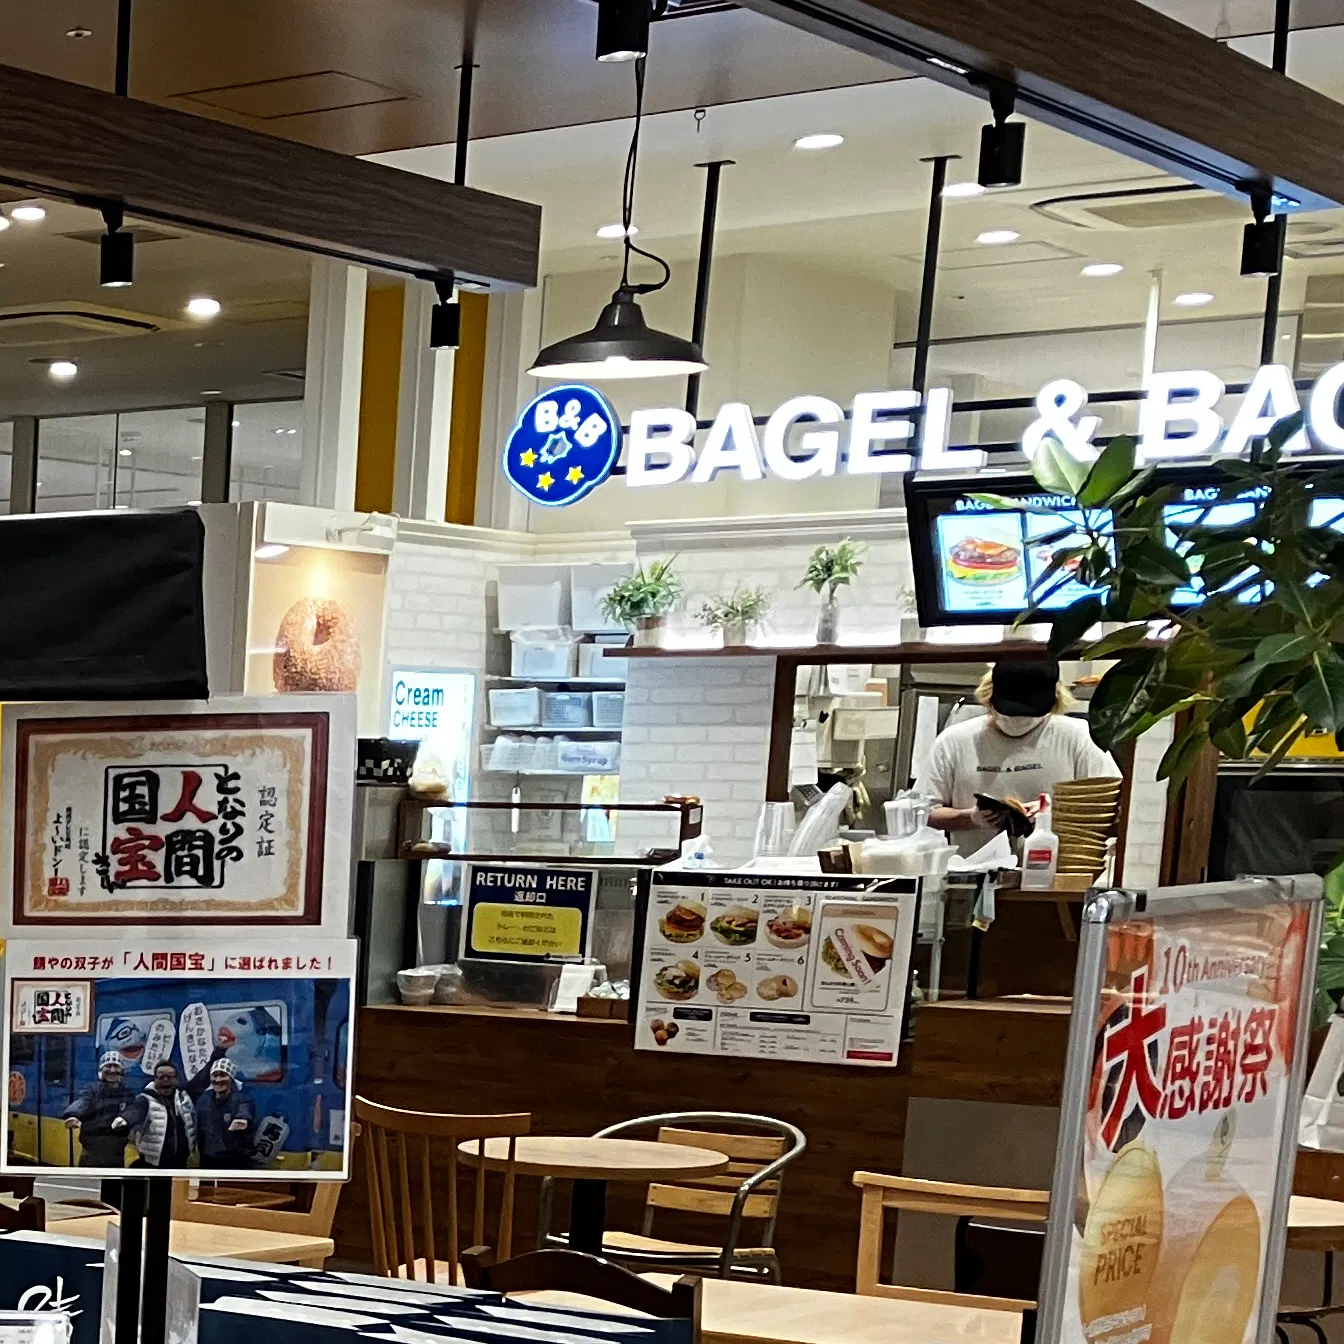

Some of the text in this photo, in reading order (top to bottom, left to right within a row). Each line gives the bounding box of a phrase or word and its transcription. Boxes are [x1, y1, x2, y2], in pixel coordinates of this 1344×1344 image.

[534, 400, 608, 448] B&B
[626, 388, 988, 487] BAGEL
[1023, 379, 1101, 462] &
[393, 711, 439, 728] CHEESE
[395, 680, 444, 706] Cream
[110, 769, 165, 884] 国宝
[160, 770, 218, 888] 人間
[214, 771, 246, 862] となりの
[257, 785, 279, 858] 認定証
[476, 872, 587, 891] RETURN HERE
[514, 890, 547, 903] 返却口
[1101, 965, 1278, 1149] 大感謝祭
[1094, 1243, 1146, 1286] PRICE
